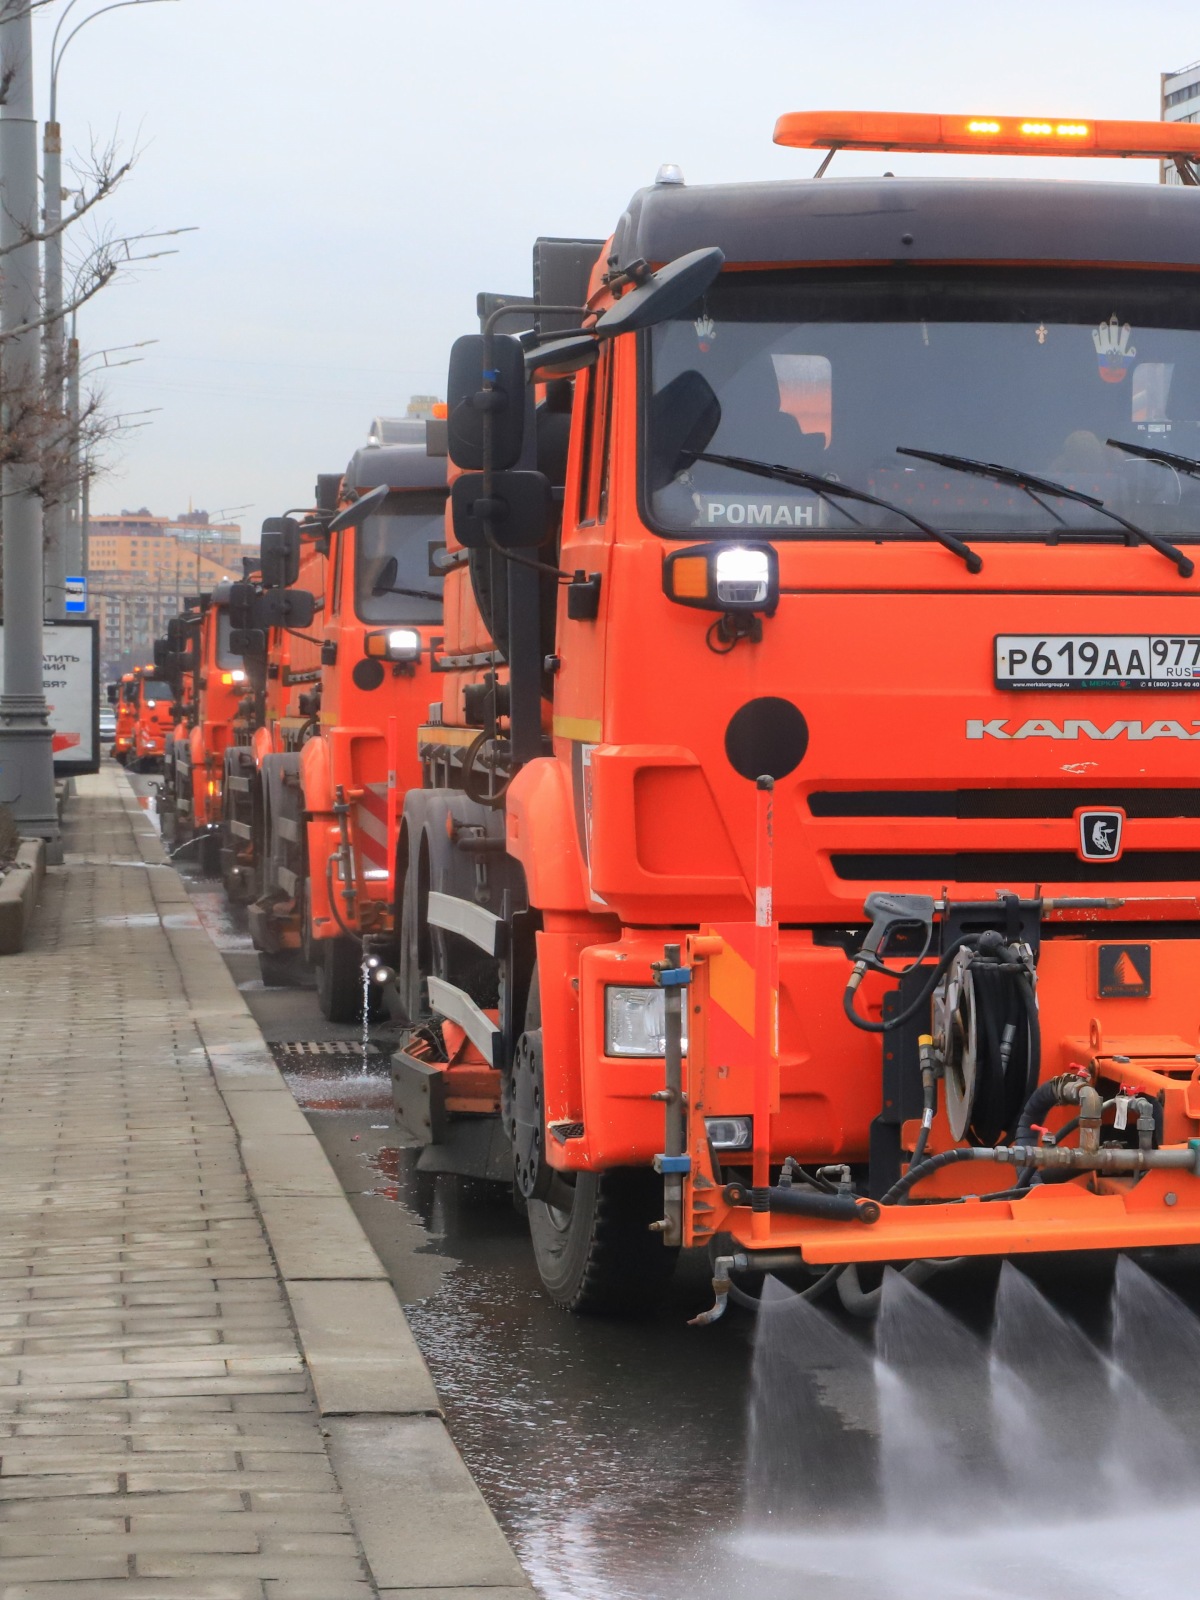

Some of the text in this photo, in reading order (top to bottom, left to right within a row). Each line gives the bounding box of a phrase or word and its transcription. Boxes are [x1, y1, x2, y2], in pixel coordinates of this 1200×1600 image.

[707, 503, 813, 526] РОМАН
[1008, 641, 1145, 676] Р619АА
[1166, 667, 1191, 677] RUS
